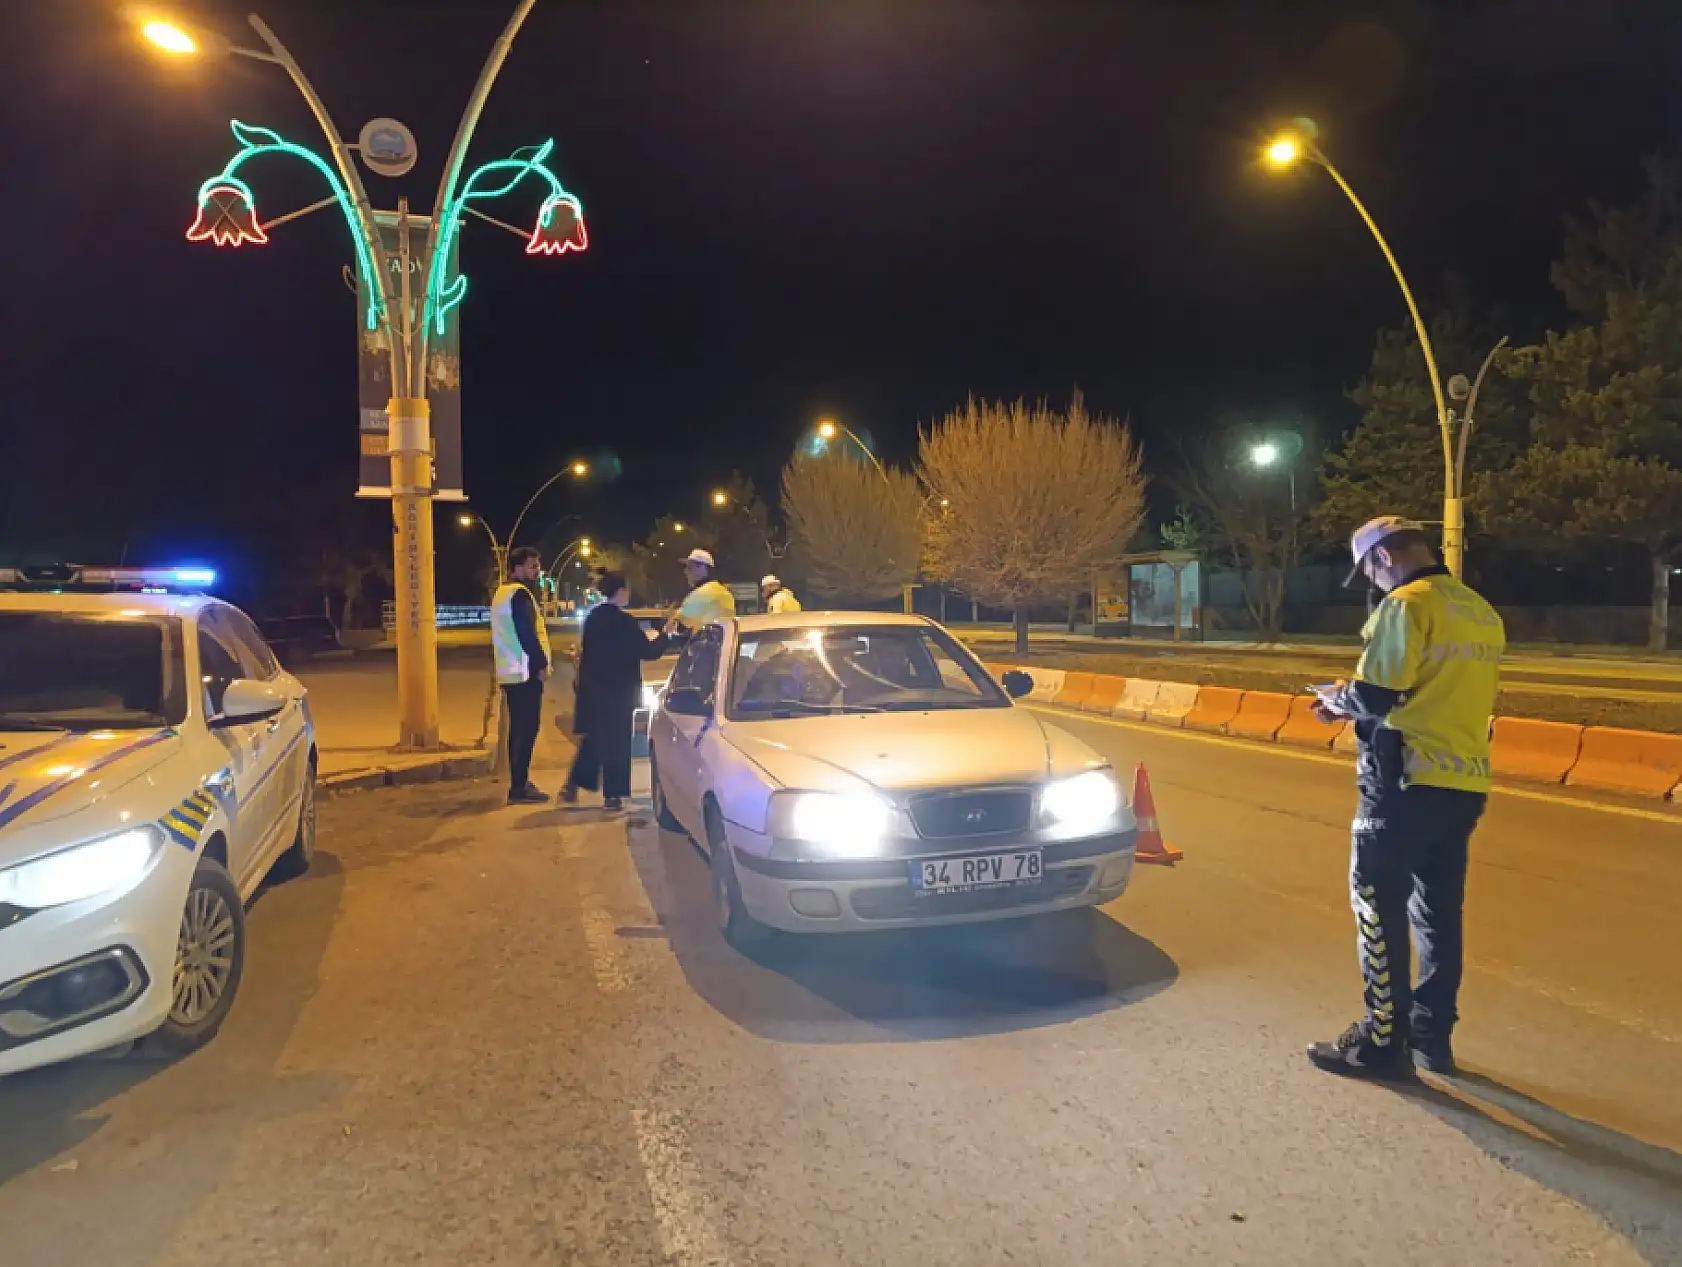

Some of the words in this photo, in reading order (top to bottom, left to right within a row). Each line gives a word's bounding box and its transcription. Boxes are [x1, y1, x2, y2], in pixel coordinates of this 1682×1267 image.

[924, 862, 950, 886] 34
[962, 857, 1003, 883] RPV
[1013, 853, 1040, 877] 78
